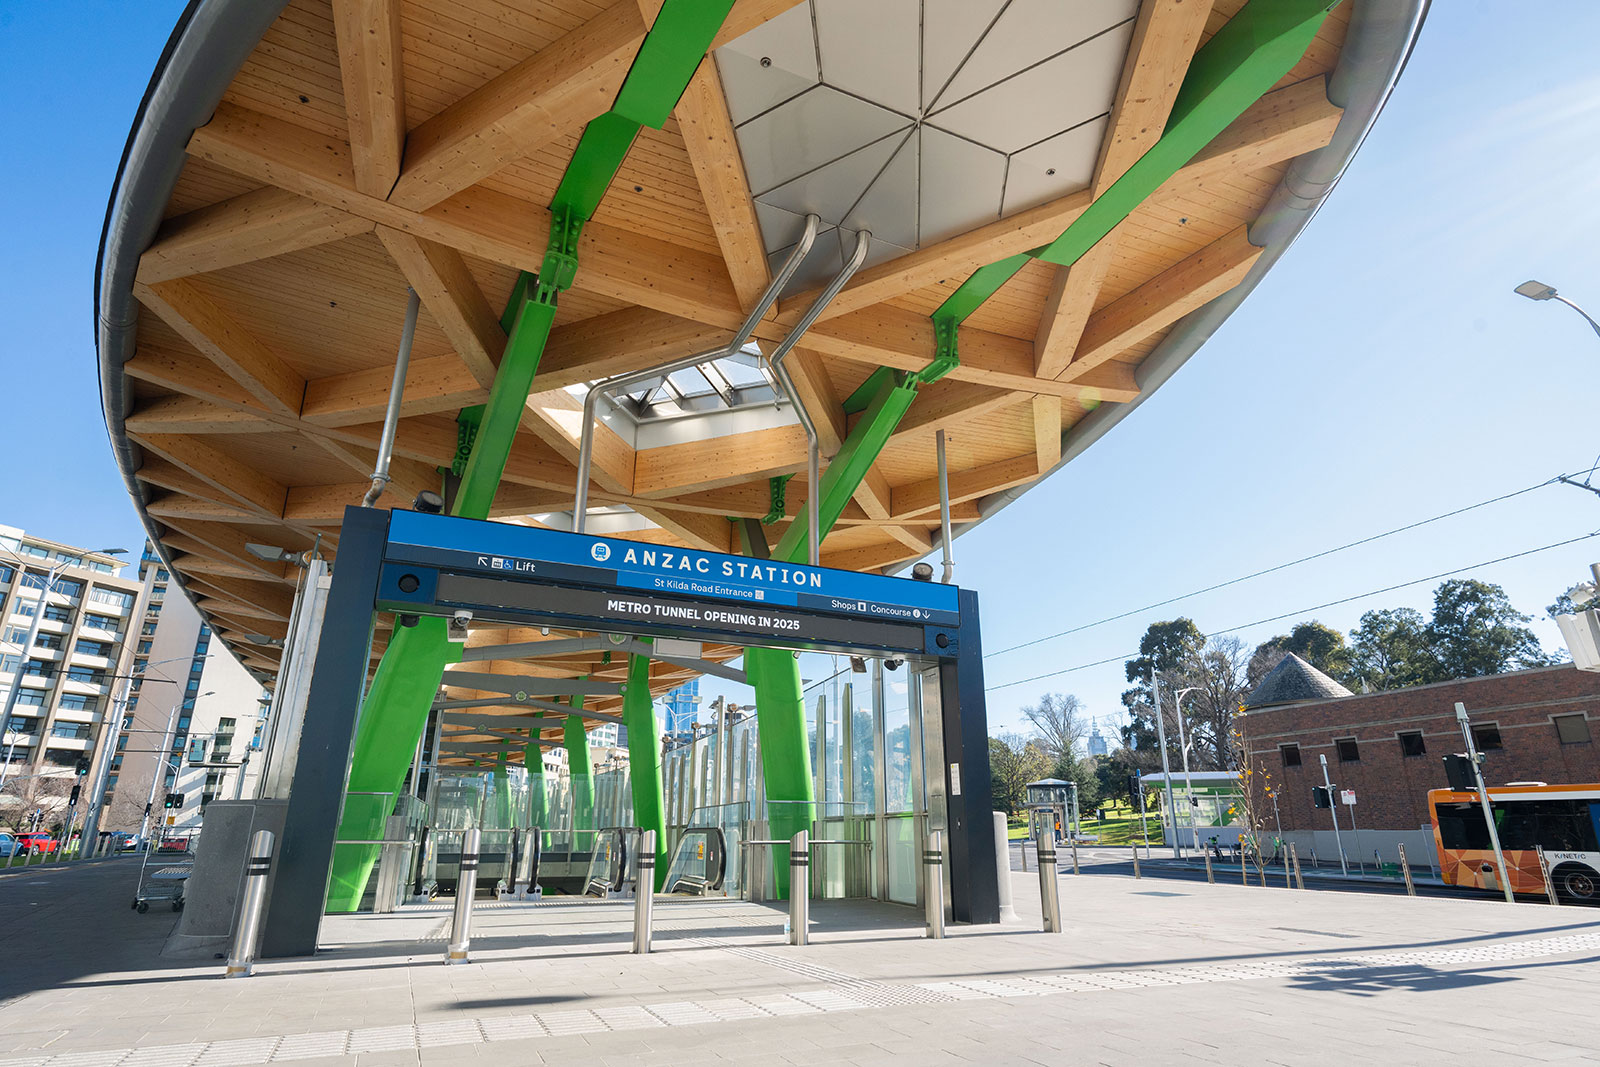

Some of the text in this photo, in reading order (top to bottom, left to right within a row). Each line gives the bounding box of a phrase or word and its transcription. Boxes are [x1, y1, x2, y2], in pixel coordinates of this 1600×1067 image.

[516, 561, 536, 572] Lift
[623, 548, 822, 587] ANZAC STATION
[654, 578, 753, 598] St Kilda Road Entrance
[831, 600, 856, 611] Shops
[871, 605, 911, 617] Concourse
[607, 600, 800, 630] METRO TUNNEL OPENING IN 2025
